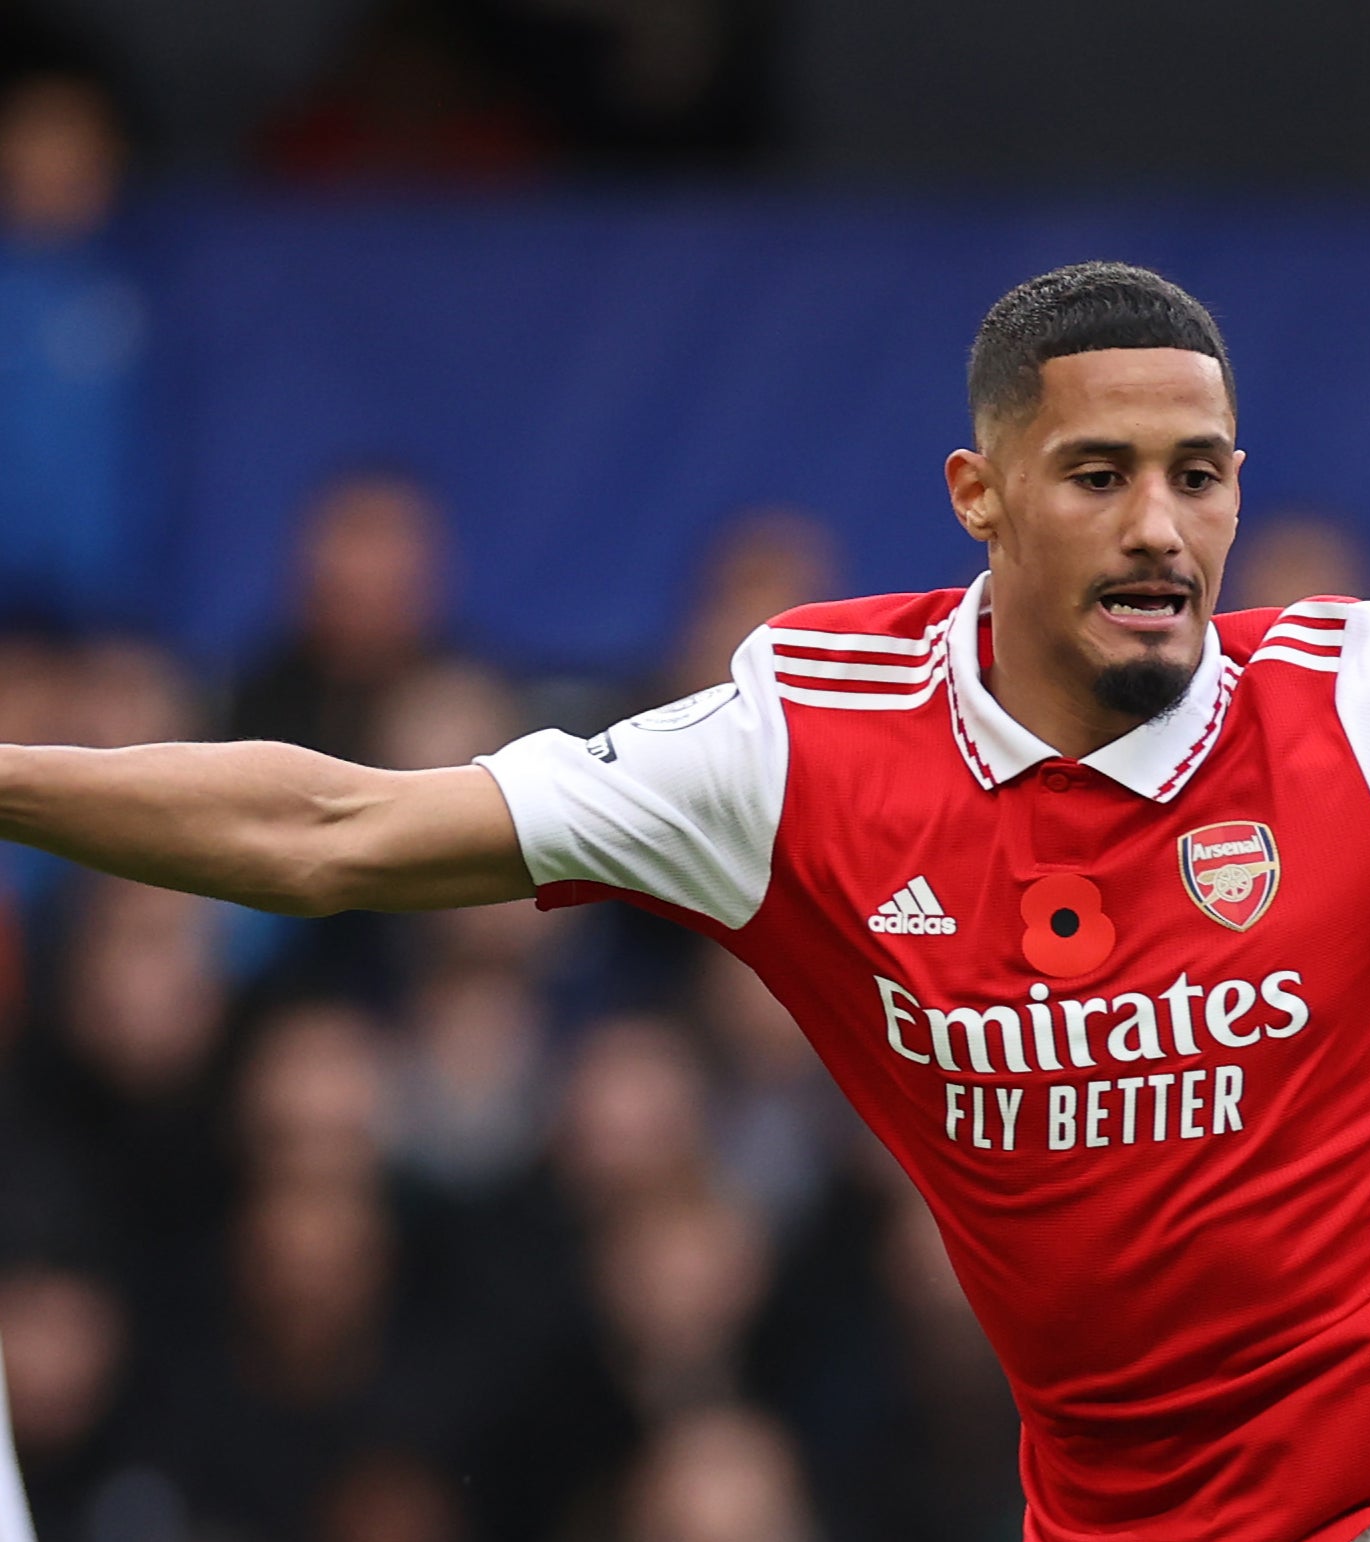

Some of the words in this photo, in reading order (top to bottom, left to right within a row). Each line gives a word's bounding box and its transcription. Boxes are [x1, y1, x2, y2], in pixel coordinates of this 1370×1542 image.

[1192, 834, 1264, 862] Arsenal
[867, 910, 958, 936] adidas
[873, 970, 1311, 1073] Emirates
[945, 1083, 1025, 1151] FLY
[1048, 1064, 1245, 1151] BETTER
